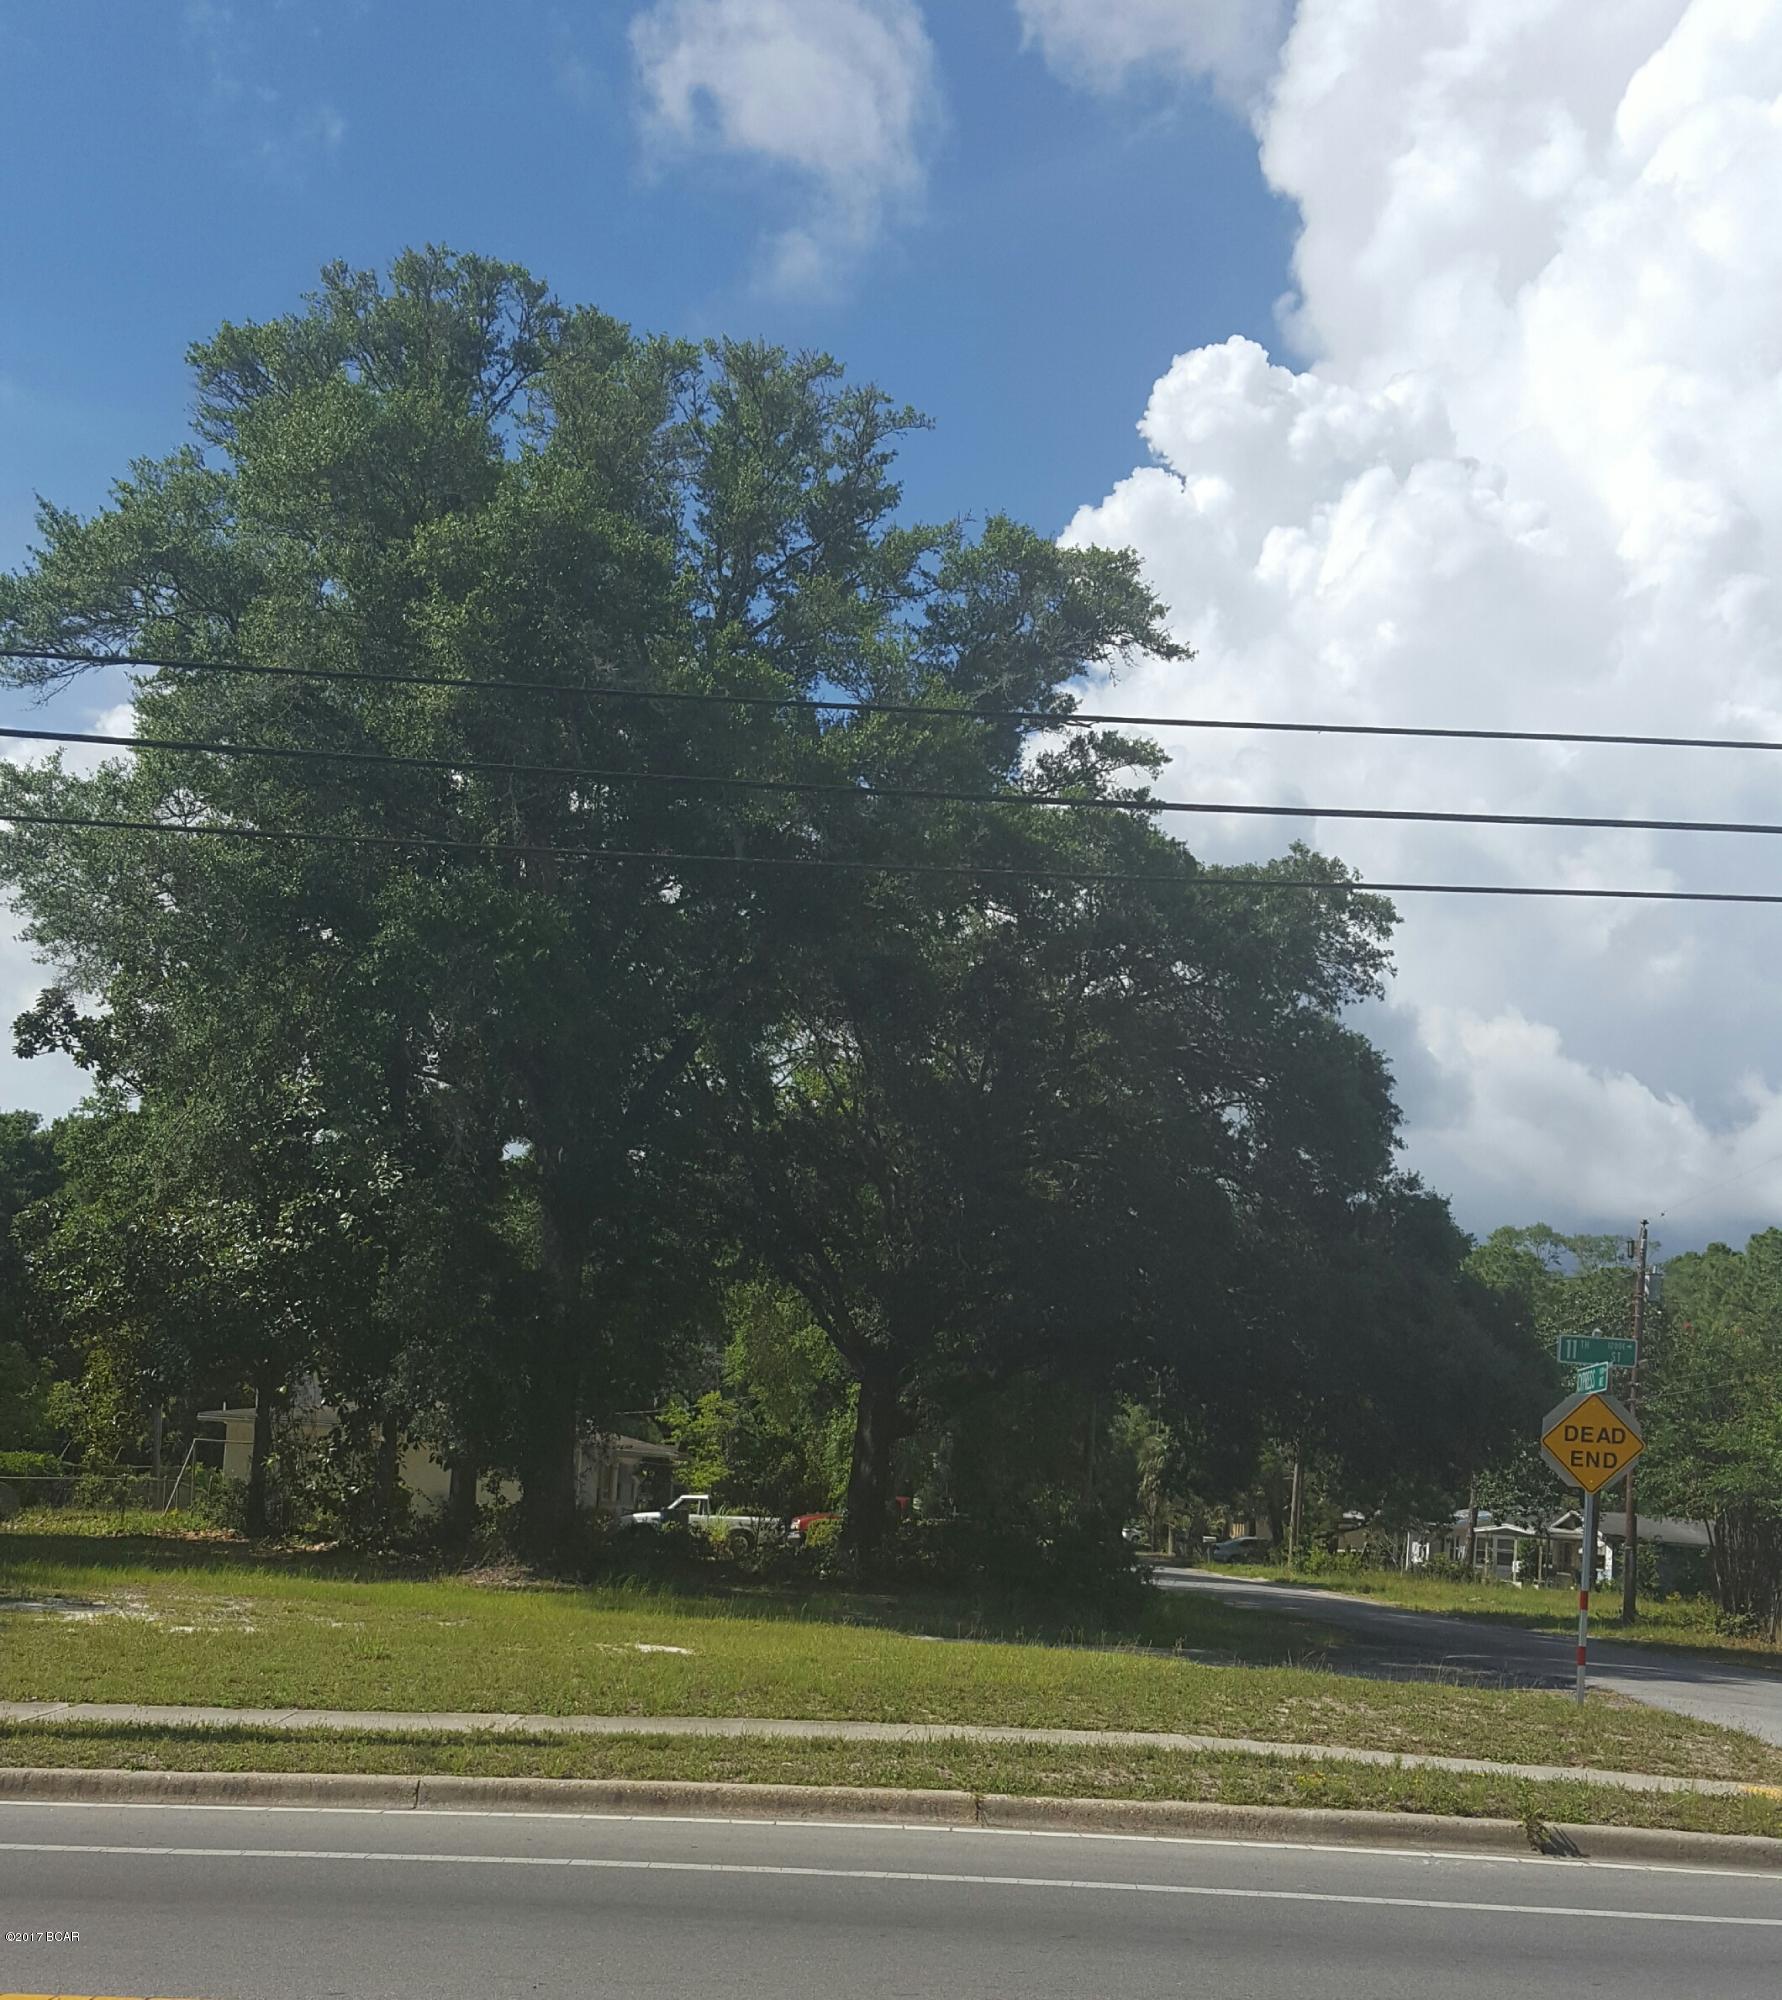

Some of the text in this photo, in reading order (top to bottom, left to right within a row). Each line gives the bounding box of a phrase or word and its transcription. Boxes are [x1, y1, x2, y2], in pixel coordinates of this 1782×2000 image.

[1611, 1352, 1621, 1363] ST
[1564, 1425, 1626, 1444] DEAD
[1570, 1450, 1618, 1469] END
